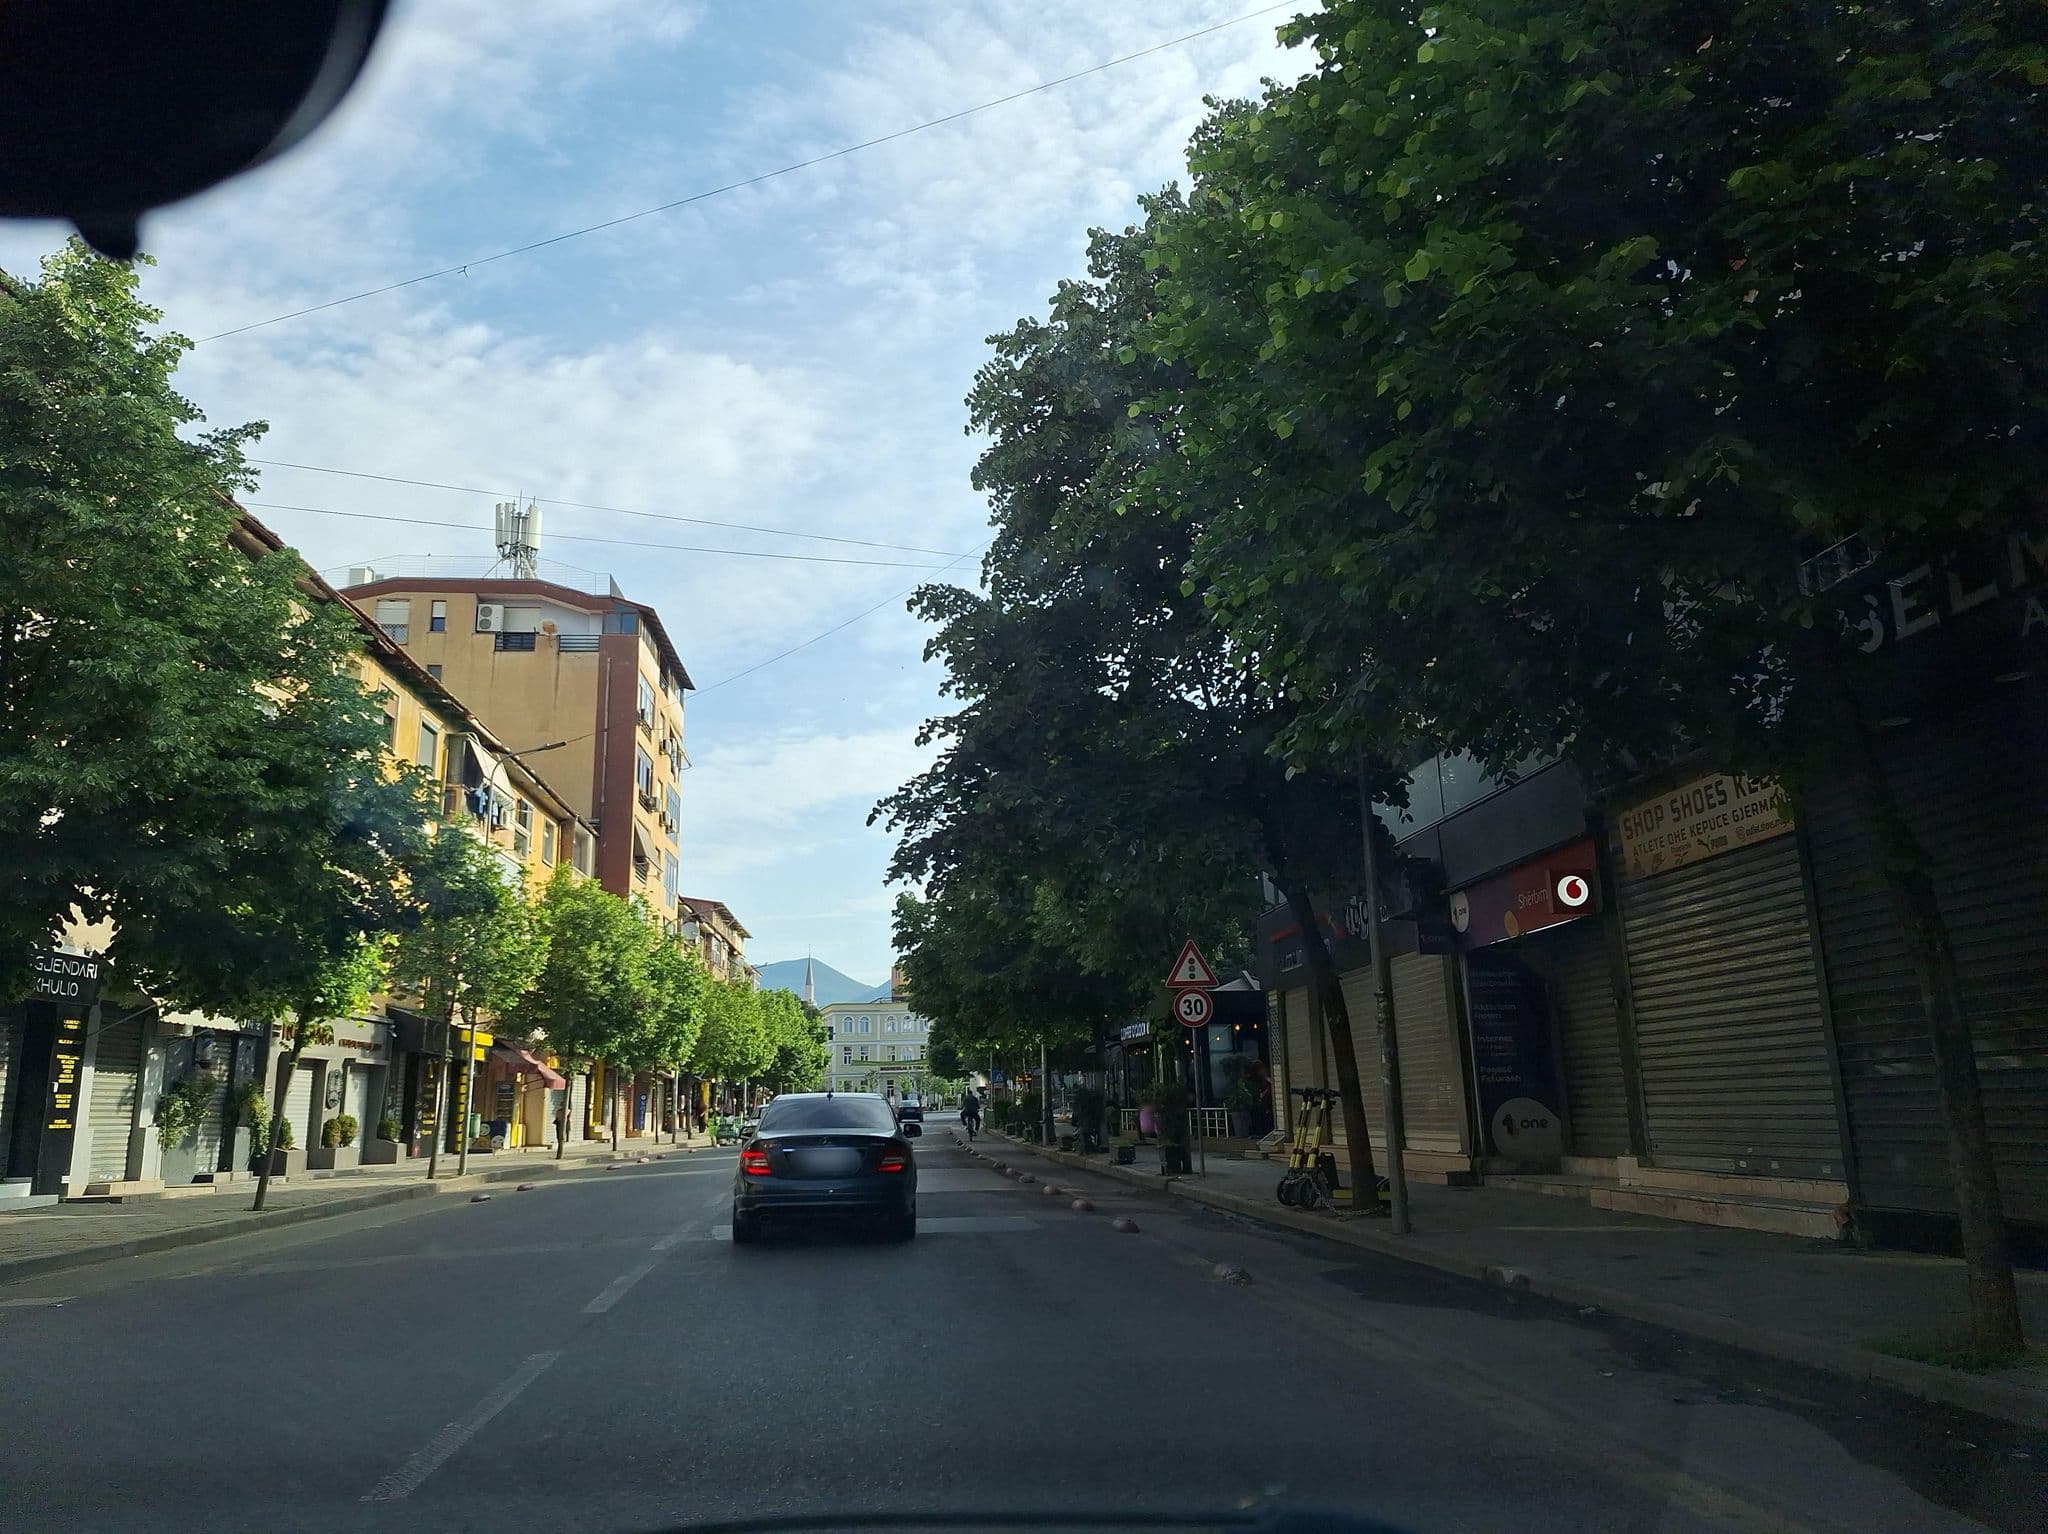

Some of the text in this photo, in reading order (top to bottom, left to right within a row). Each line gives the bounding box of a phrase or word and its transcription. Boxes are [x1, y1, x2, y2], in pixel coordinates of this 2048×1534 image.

[1623, 804, 1664, 840] SHOP
[1670, 779, 1728, 822] SHOES
[1633, 835, 1666, 857] ATLETE
[1668, 828, 1688, 845] DHE
[1690, 813, 1730, 838] KEPUCE
[1183, 999, 1204, 1016] 30
[1520, 1117, 1549, 1129] one
